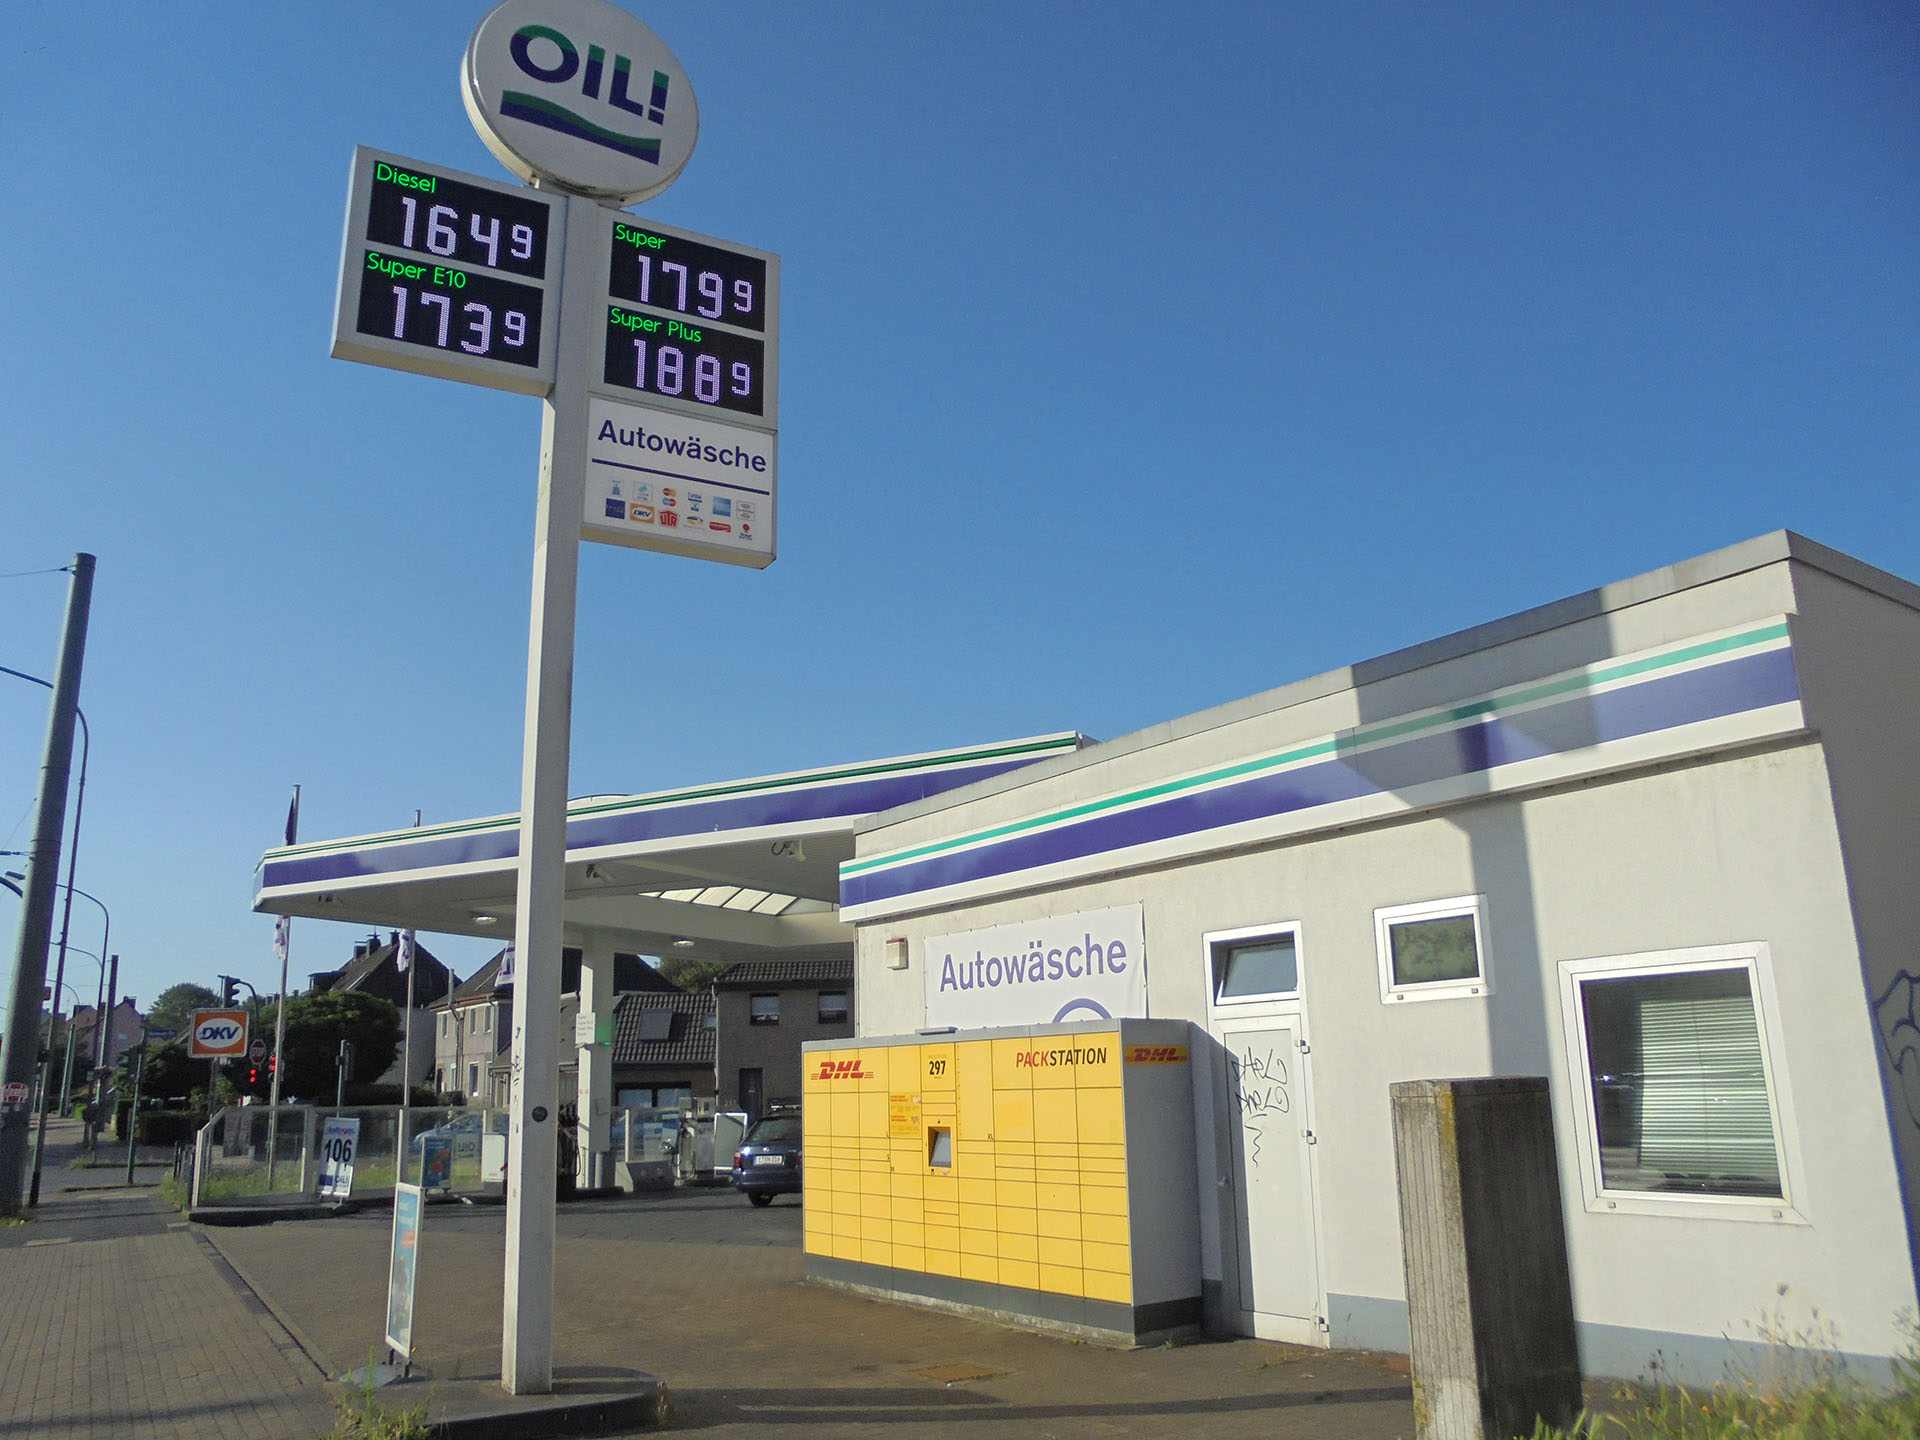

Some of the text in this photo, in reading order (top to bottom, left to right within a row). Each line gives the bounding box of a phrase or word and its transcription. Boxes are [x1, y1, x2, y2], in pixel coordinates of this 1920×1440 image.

[509, 24, 669, 126] OIL!
[376, 163, 437, 194] Diesel
[616, 224, 667, 250] Super
[367, 252, 467, 289] Super E10
[610, 307, 703, 343] Super Plus
[597, 419, 767, 473] Autowäsche
[939, 933, 1127, 993] Autowäsche
[200, 1026, 241, 1040] DKV
[929, 1060, 946, 1075] 297
[1016, 1047, 1107, 1068] PACKSTATION
[1133, 1047, 1179, 1063] DHL
[819, 1060, 865, 1080] DHL
[324, 1138, 353, 1163] 106
